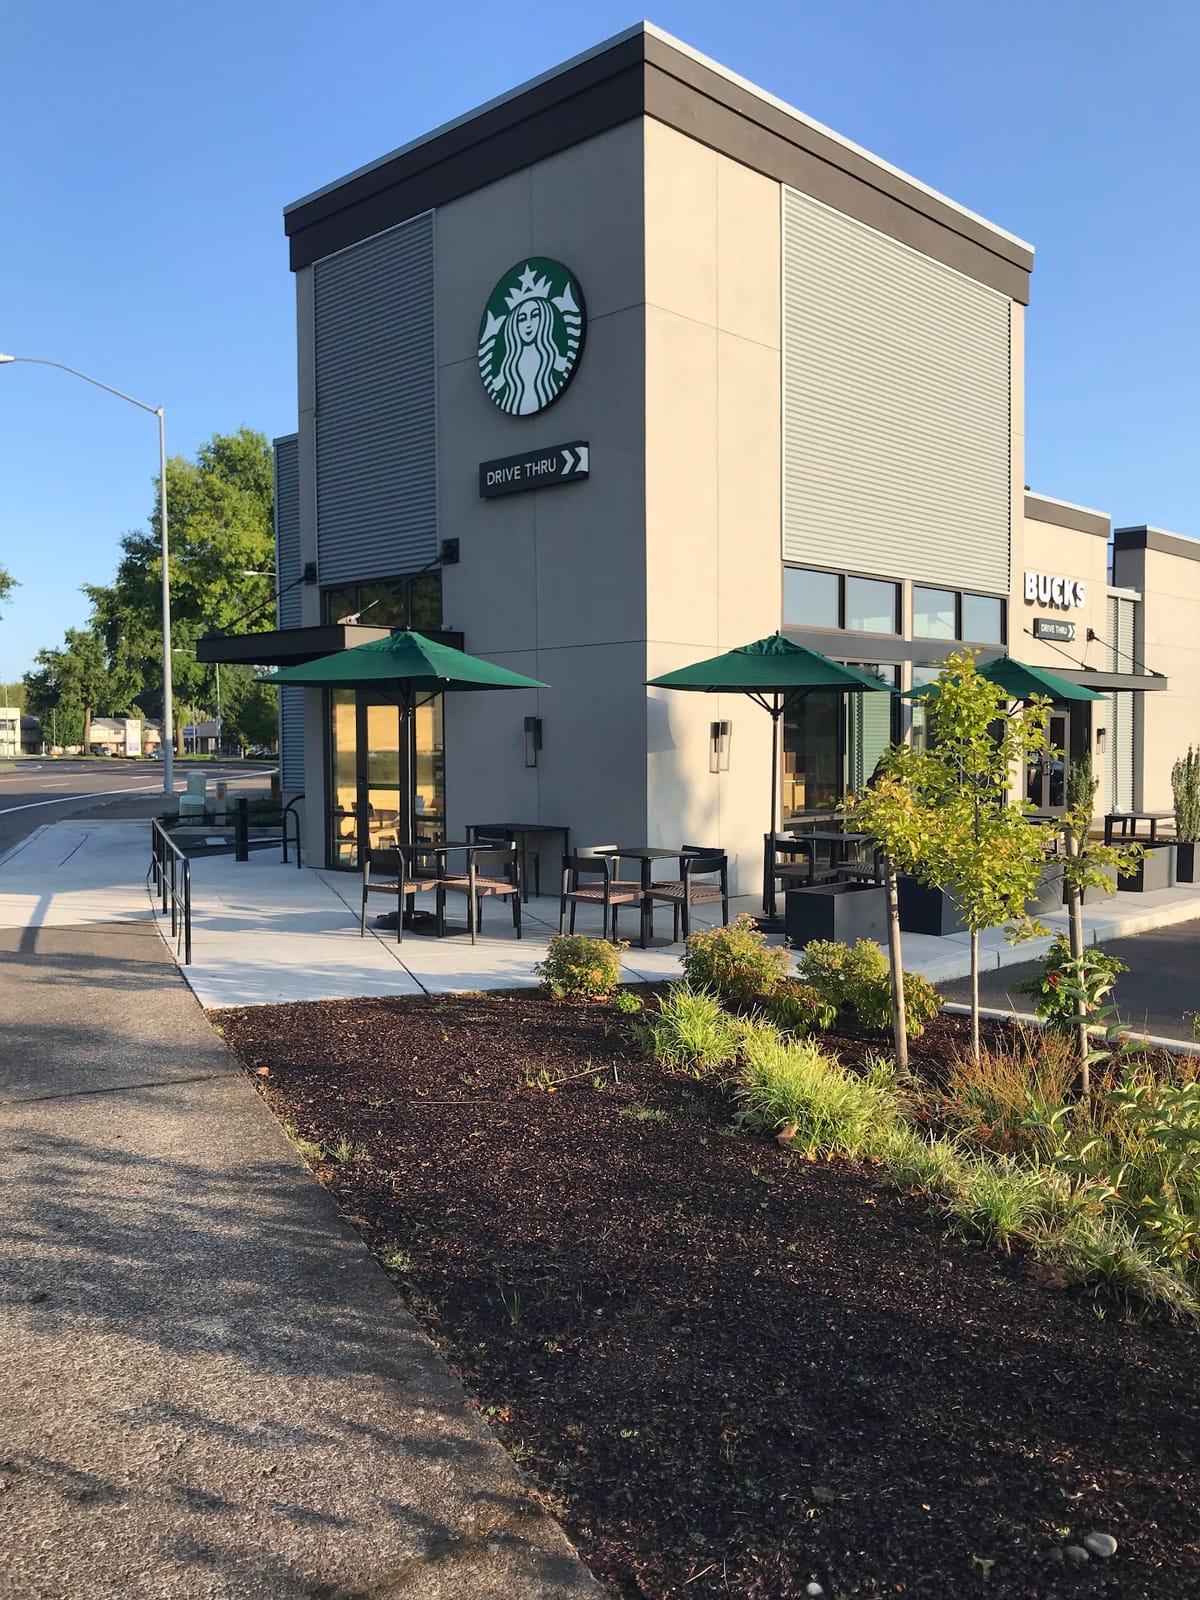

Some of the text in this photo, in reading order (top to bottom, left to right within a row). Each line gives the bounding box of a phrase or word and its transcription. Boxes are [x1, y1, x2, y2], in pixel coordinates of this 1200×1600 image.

[486, 457, 557, 486] DRIVE THRU
[1024, 571, 1086, 609] BUCKS
